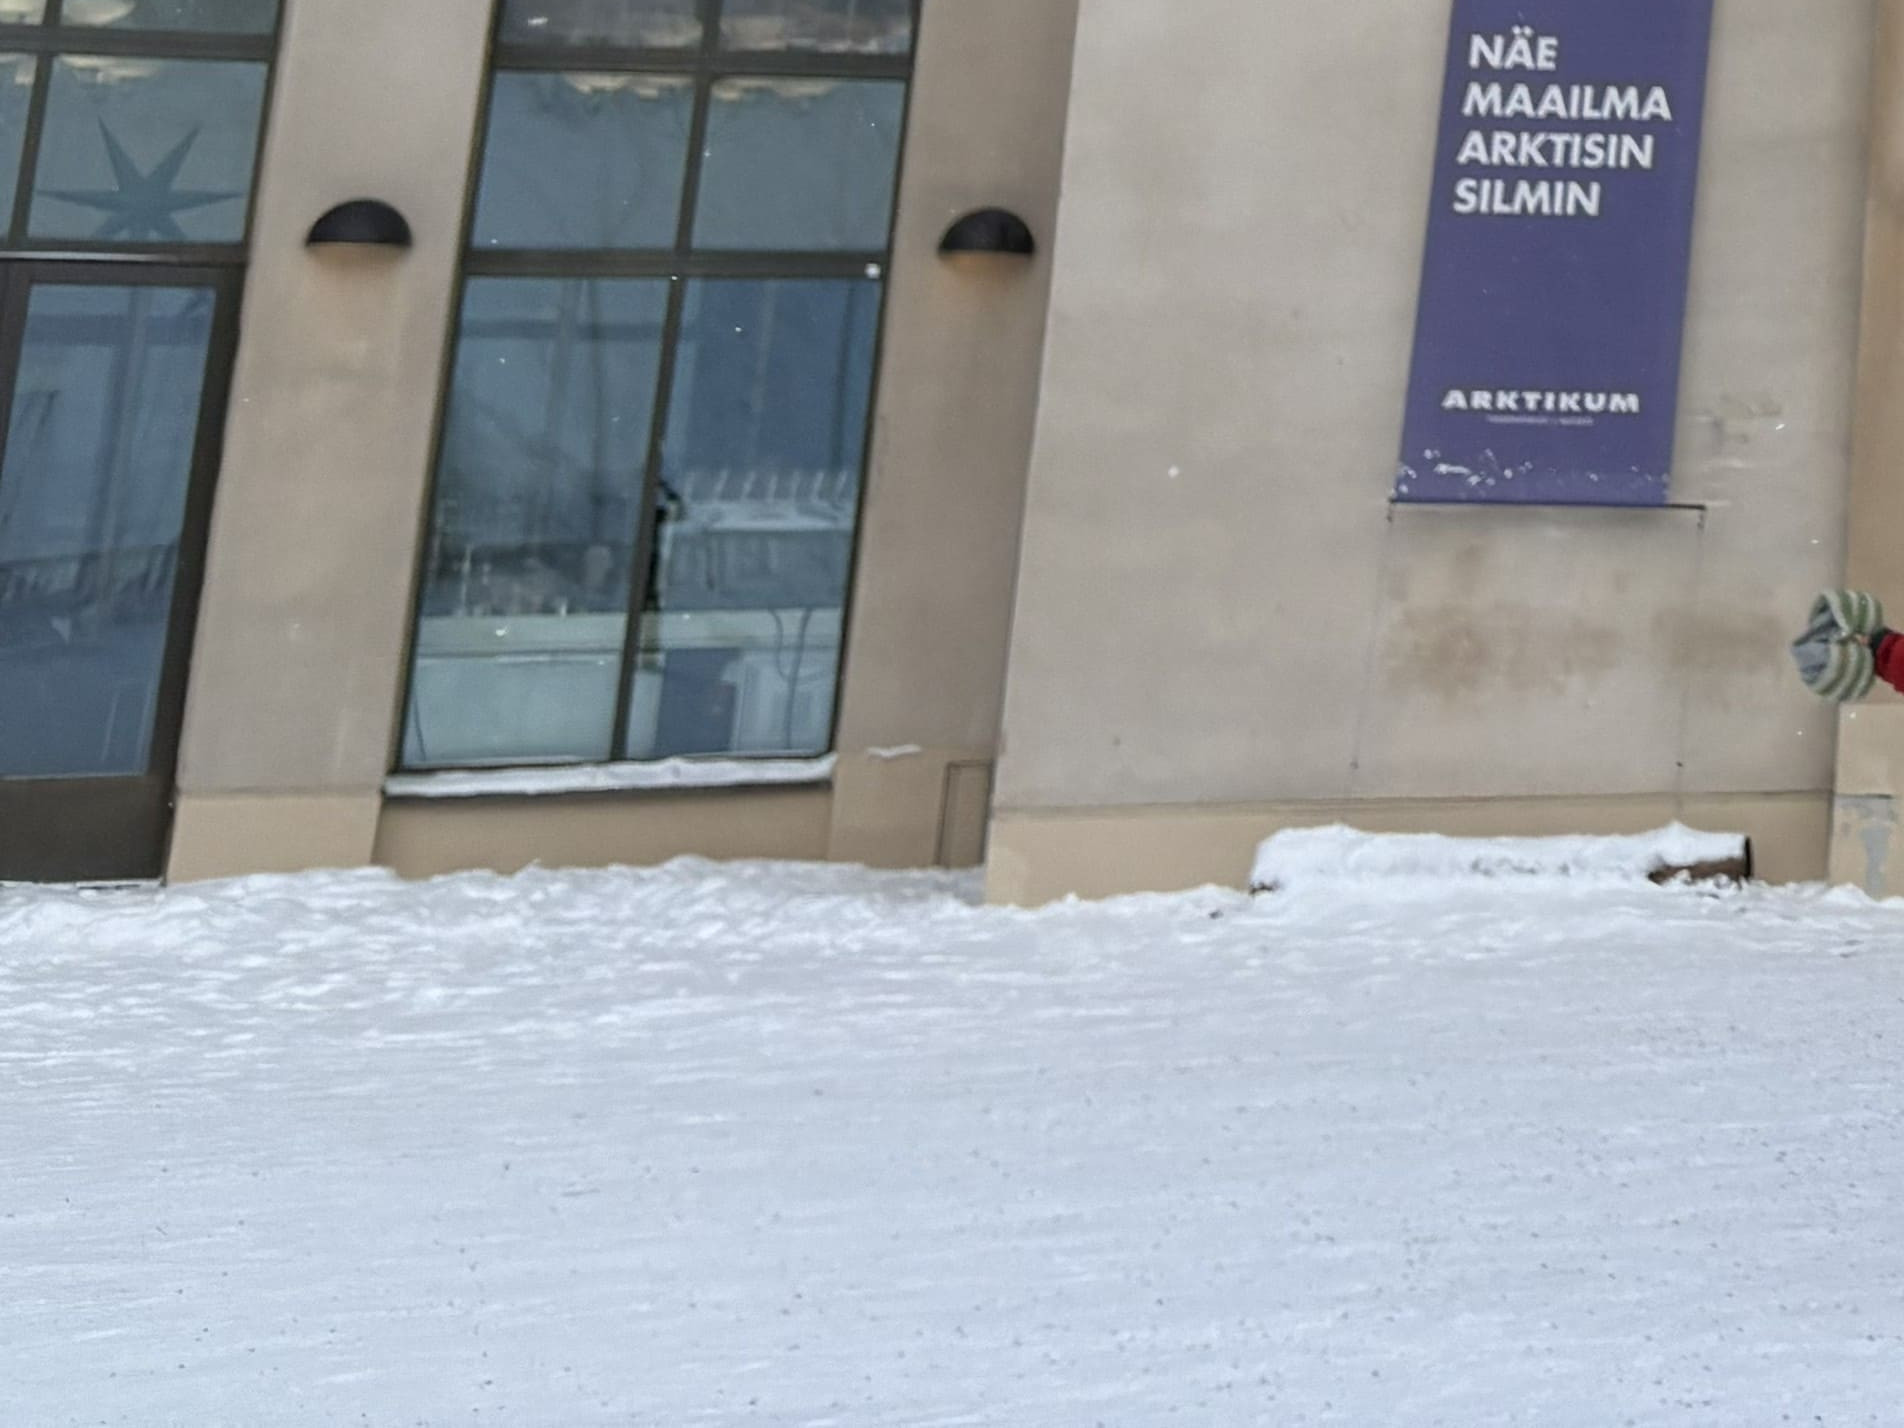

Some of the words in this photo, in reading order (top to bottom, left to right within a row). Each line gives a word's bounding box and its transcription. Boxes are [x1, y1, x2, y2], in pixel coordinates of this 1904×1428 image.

[1468, 24, 1559, 71] NÄE
[1461, 81, 1673, 122] MAAILMA
[1455, 129, 1655, 170] ARKTISIN
[1452, 176, 1602, 217] SILMIN
[1440, 388, 1640, 414] ARKTIKUM
